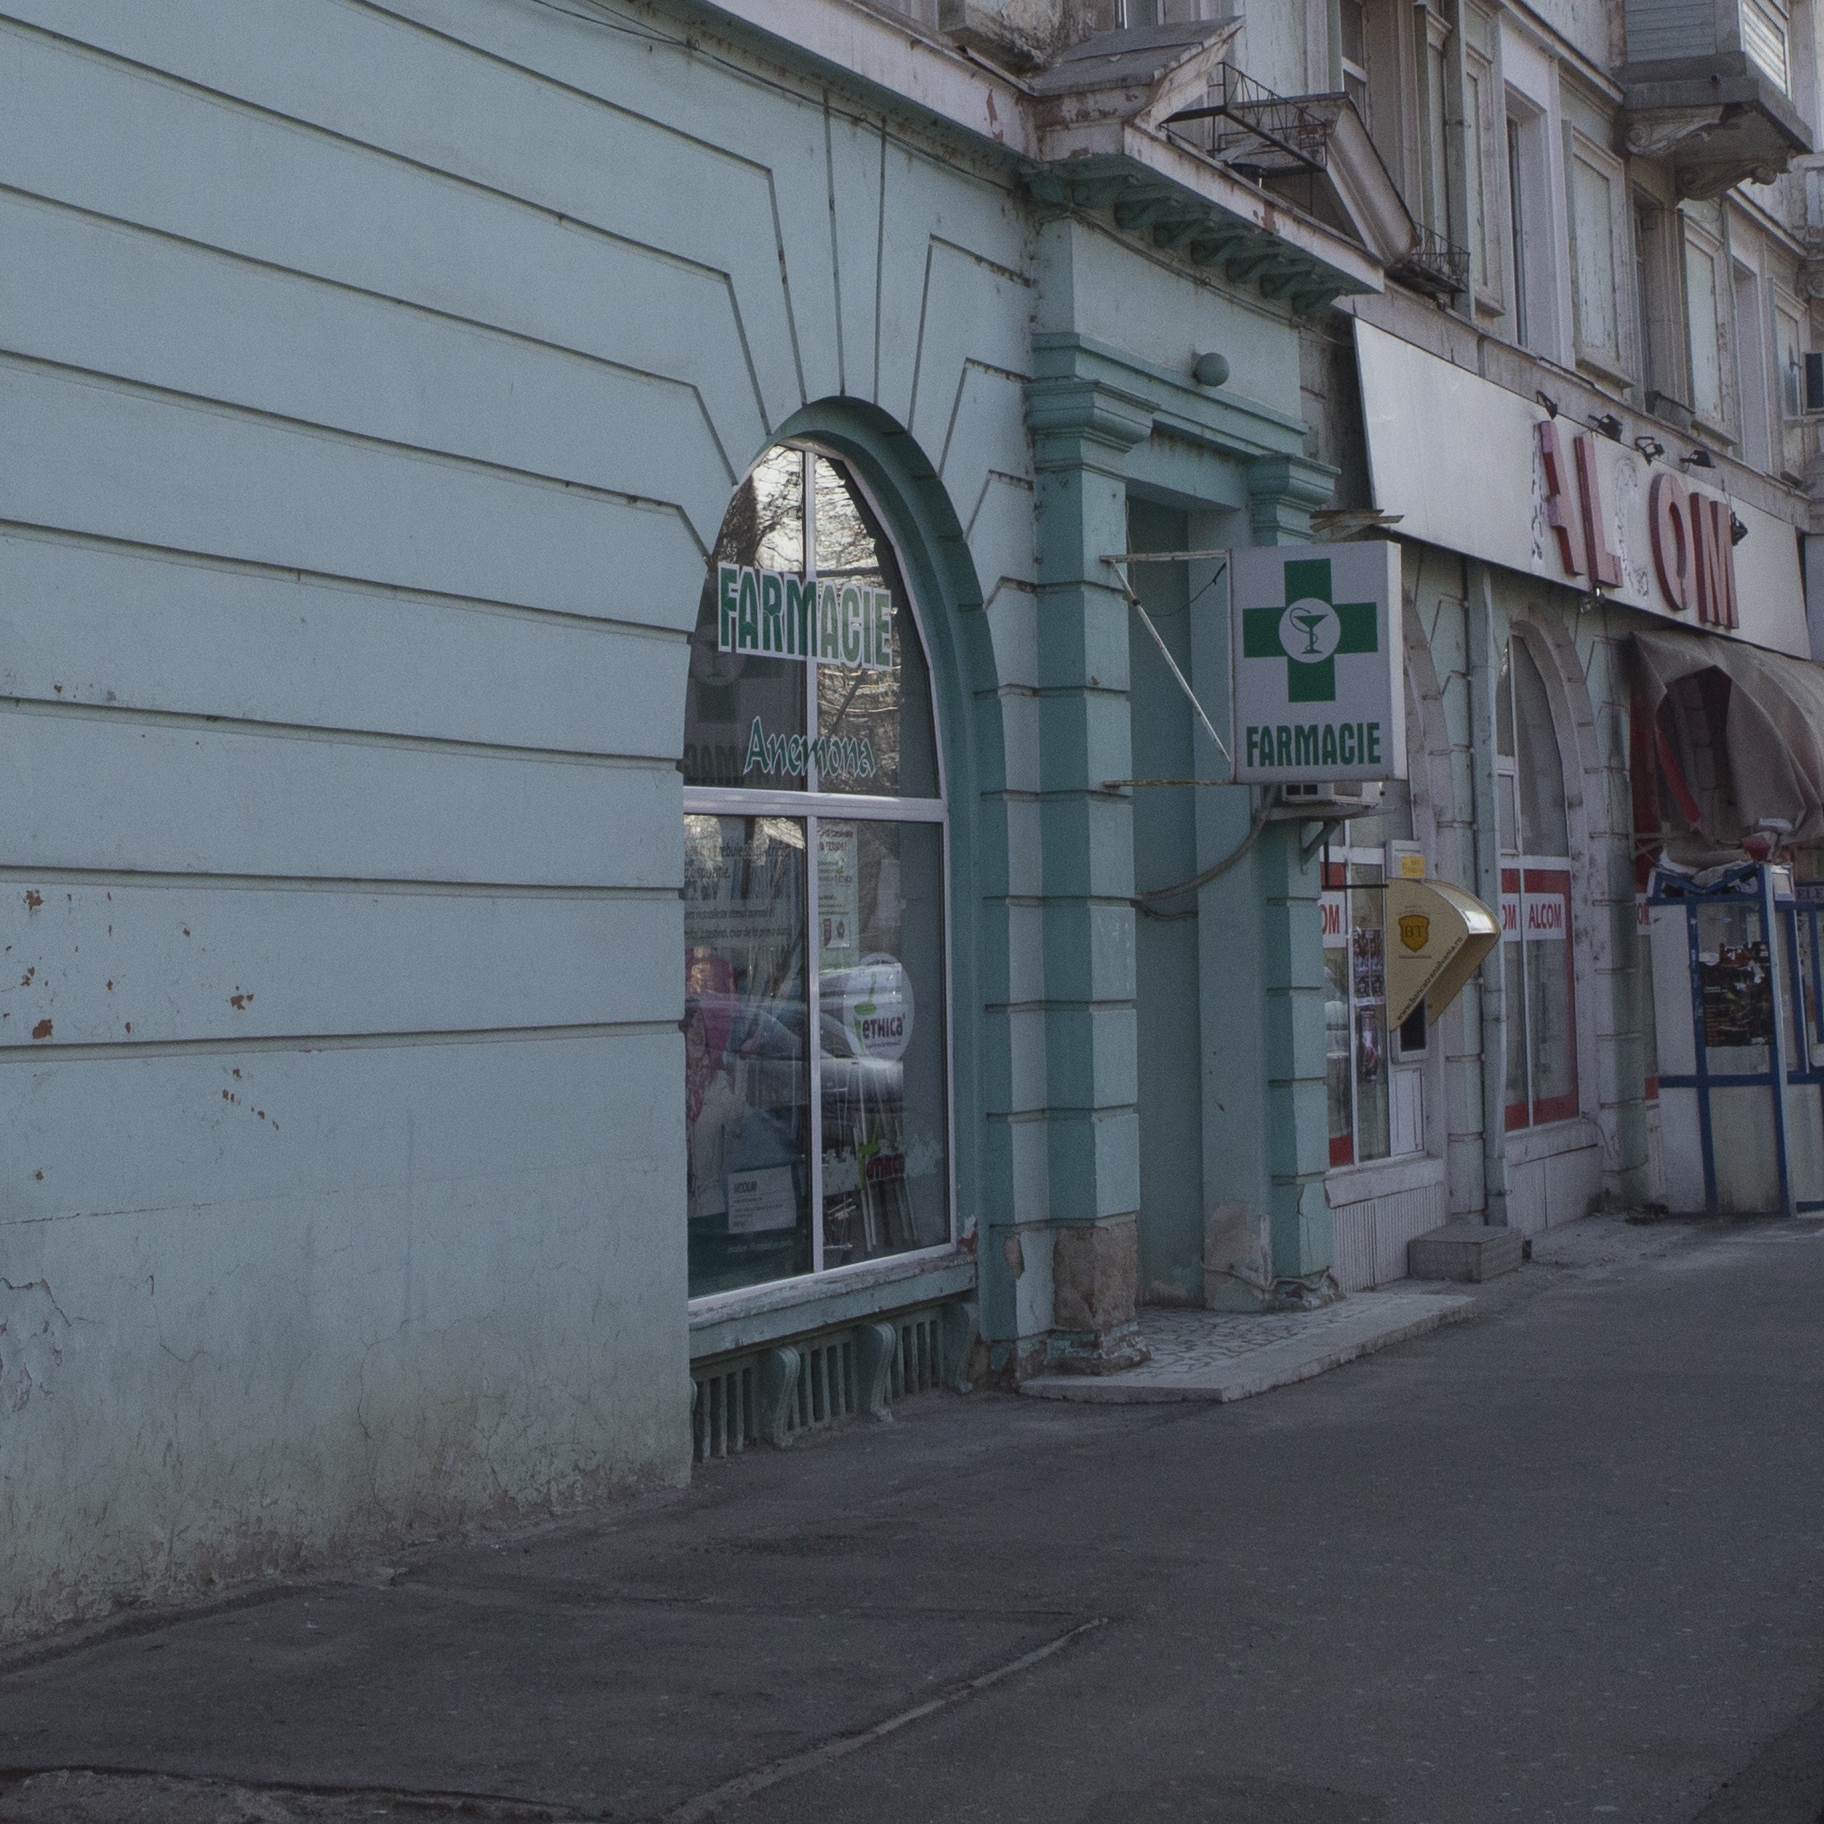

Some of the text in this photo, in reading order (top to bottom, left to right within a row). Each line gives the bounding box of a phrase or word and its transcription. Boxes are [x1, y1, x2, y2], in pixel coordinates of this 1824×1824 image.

[1533, 420, 1740, 631] ALOM
[718, 562, 892, 671] FARMACIE
[743, 716, 876, 777] Anemona
[1245, 722, 1381, 767] FARMACIE
[1404, 925, 1423, 937] BT
[1528, 903, 1563, 929] ALCOM
